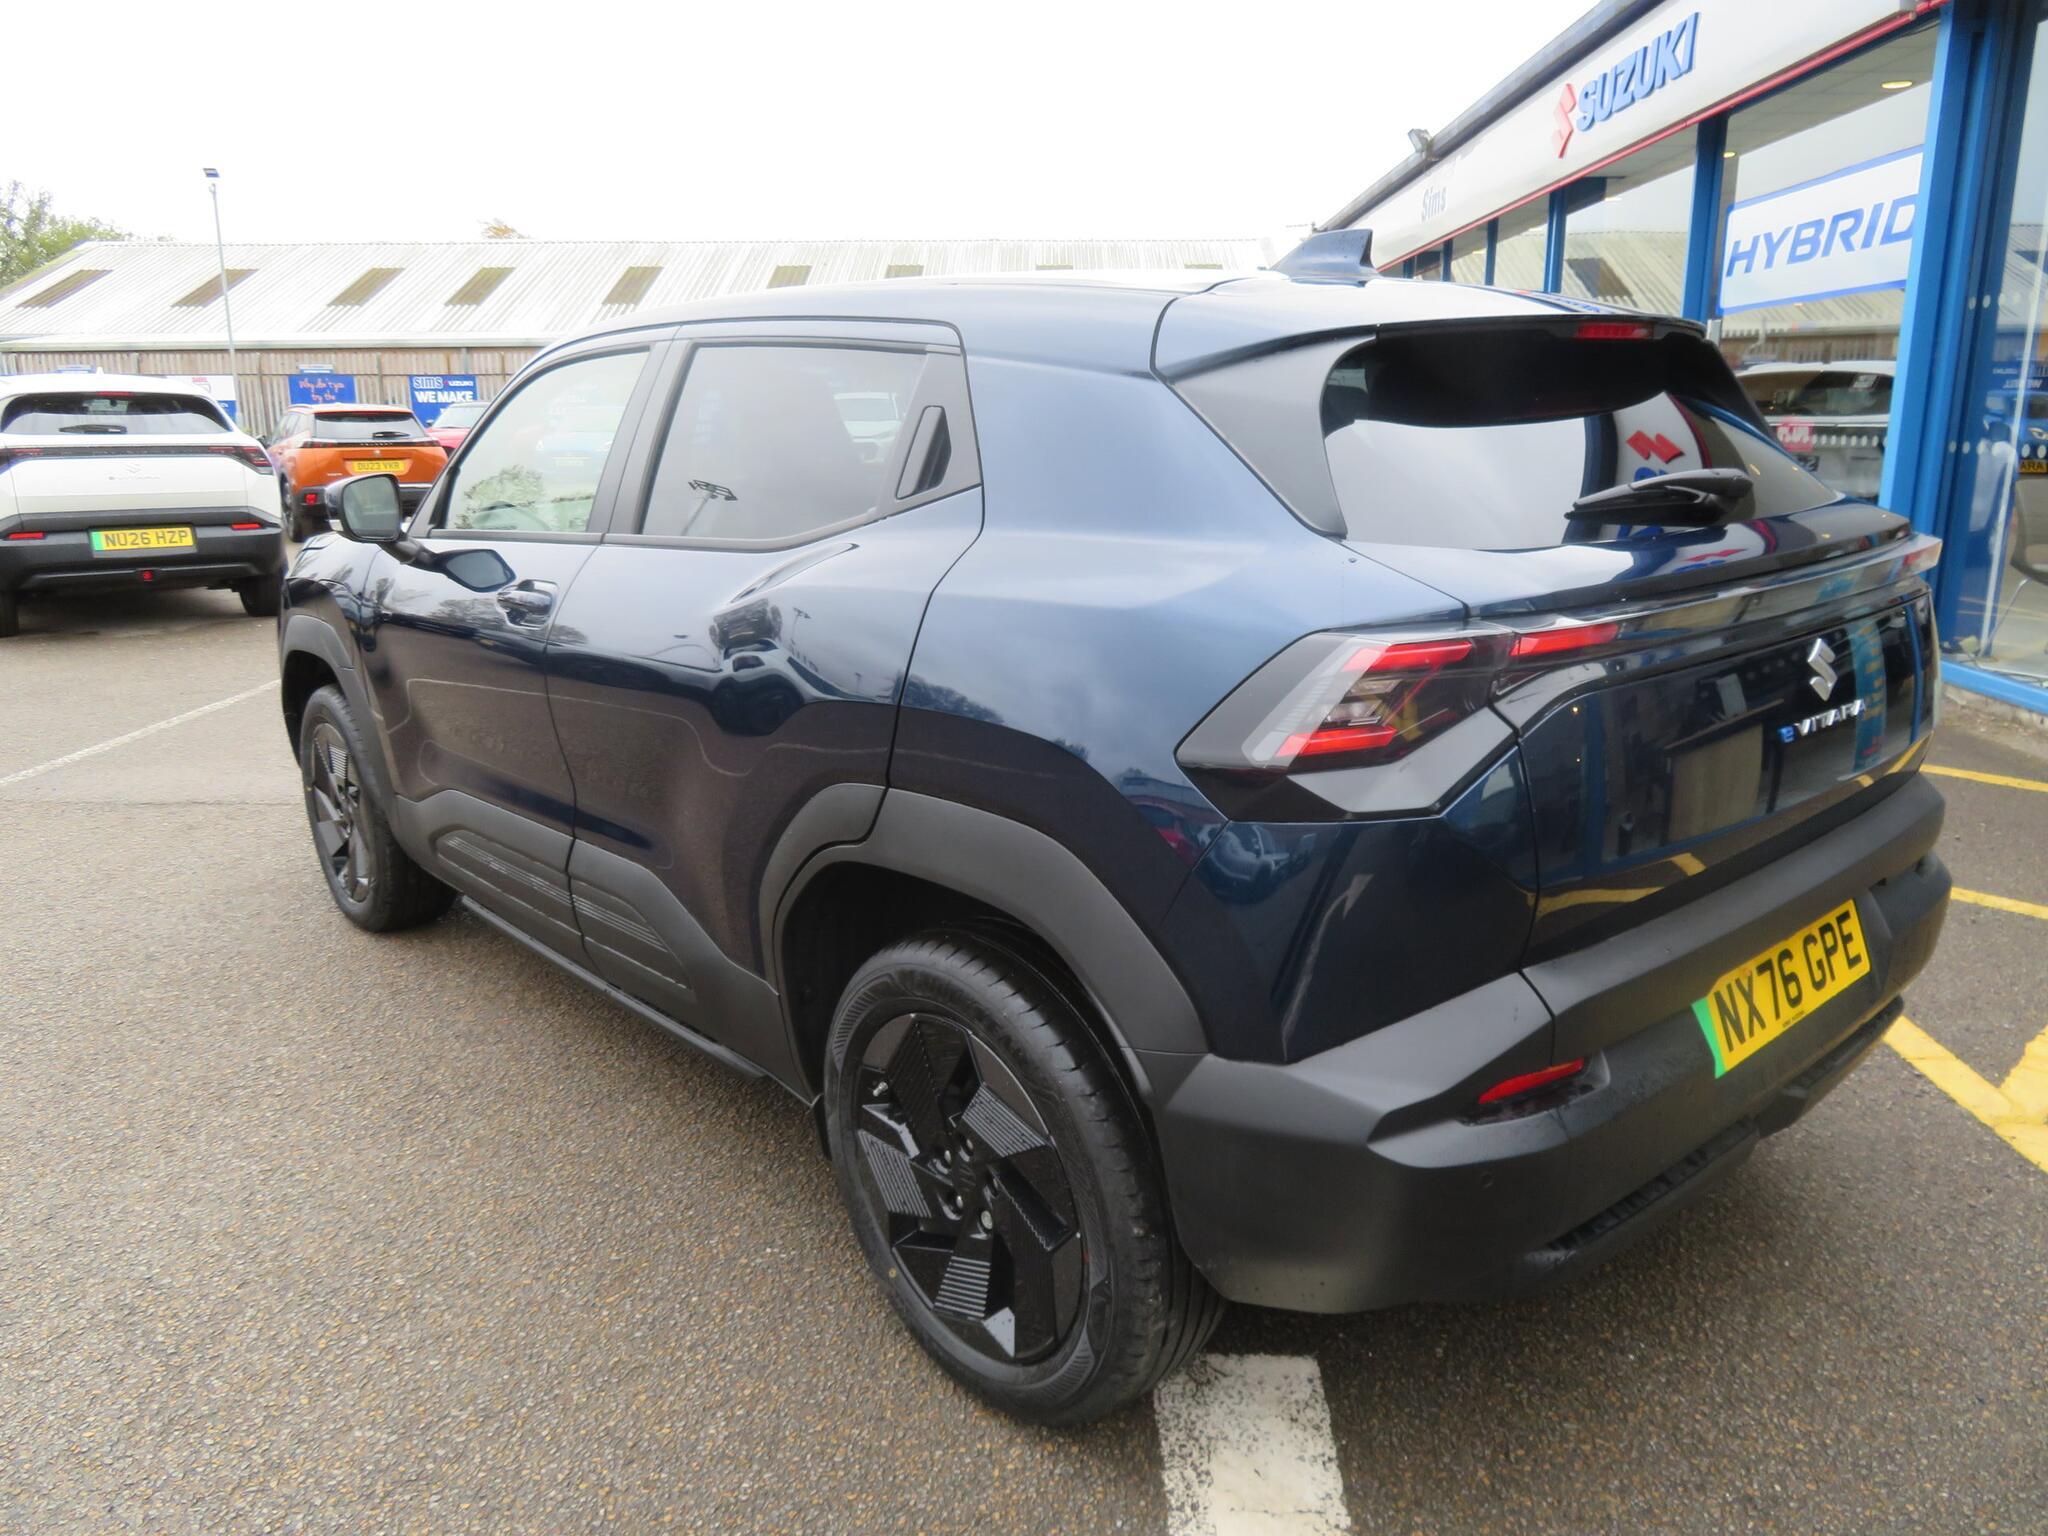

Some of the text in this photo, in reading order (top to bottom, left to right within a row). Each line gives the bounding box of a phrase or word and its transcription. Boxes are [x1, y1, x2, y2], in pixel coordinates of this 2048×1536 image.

[1576, 12, 1700, 132] SUZUKI
[1725, 193, 1919, 278] HYBRID
[414, 391, 474, 403] WE MAKE
[104, 529, 188, 548] NU26 HZP
[1713, 909, 1863, 1053] NX76 GPE
